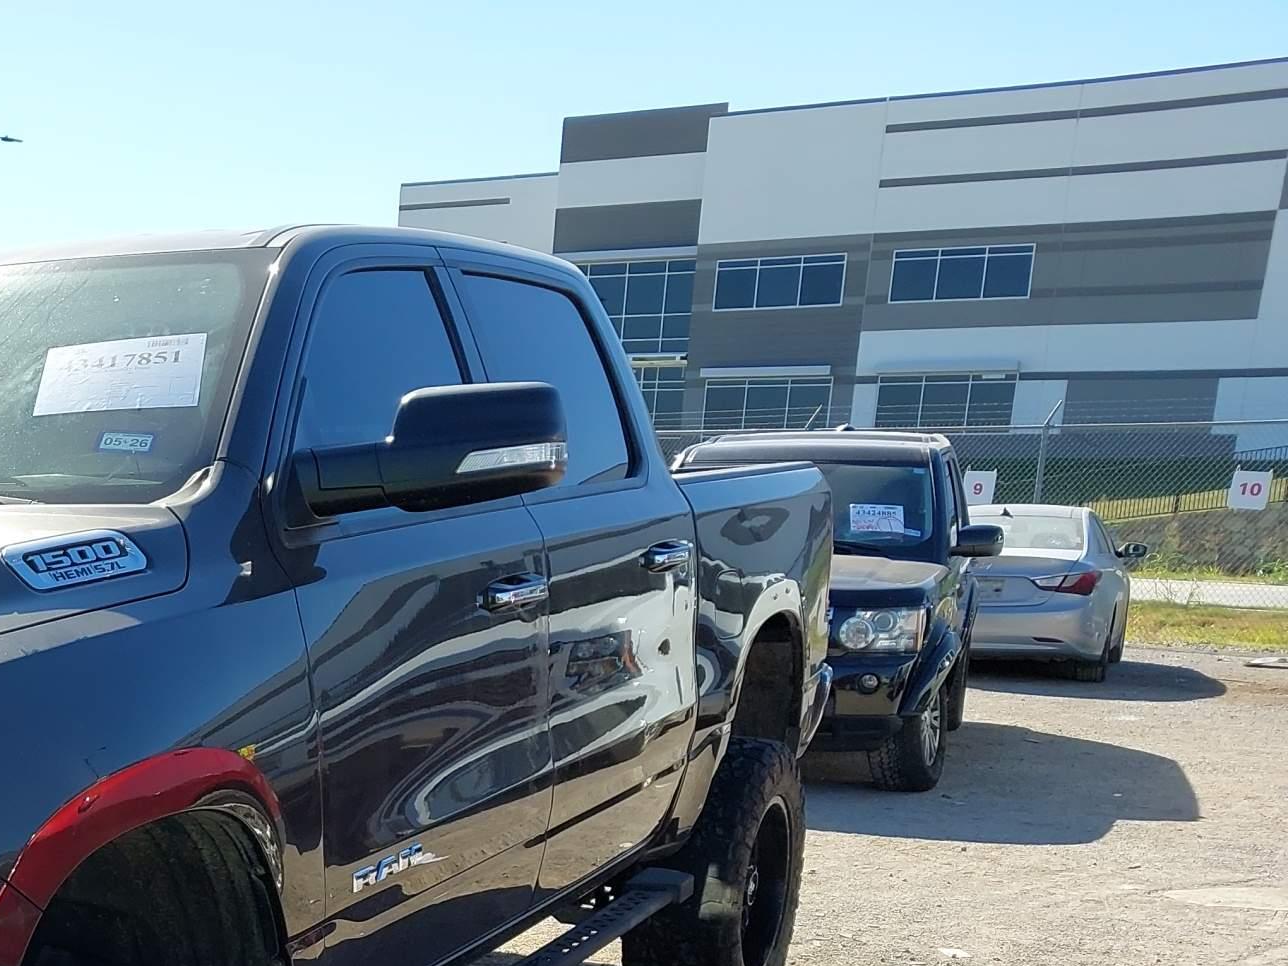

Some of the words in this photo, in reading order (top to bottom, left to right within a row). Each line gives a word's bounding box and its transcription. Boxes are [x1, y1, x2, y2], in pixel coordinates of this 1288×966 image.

[973, 482, 983, 495] 9
[1239, 482, 1263, 497] 10
[26, 541, 121, 571] 1500
[53, 566, 92, 582] HEMI
[94, 561, 126, 574] 5.7L
